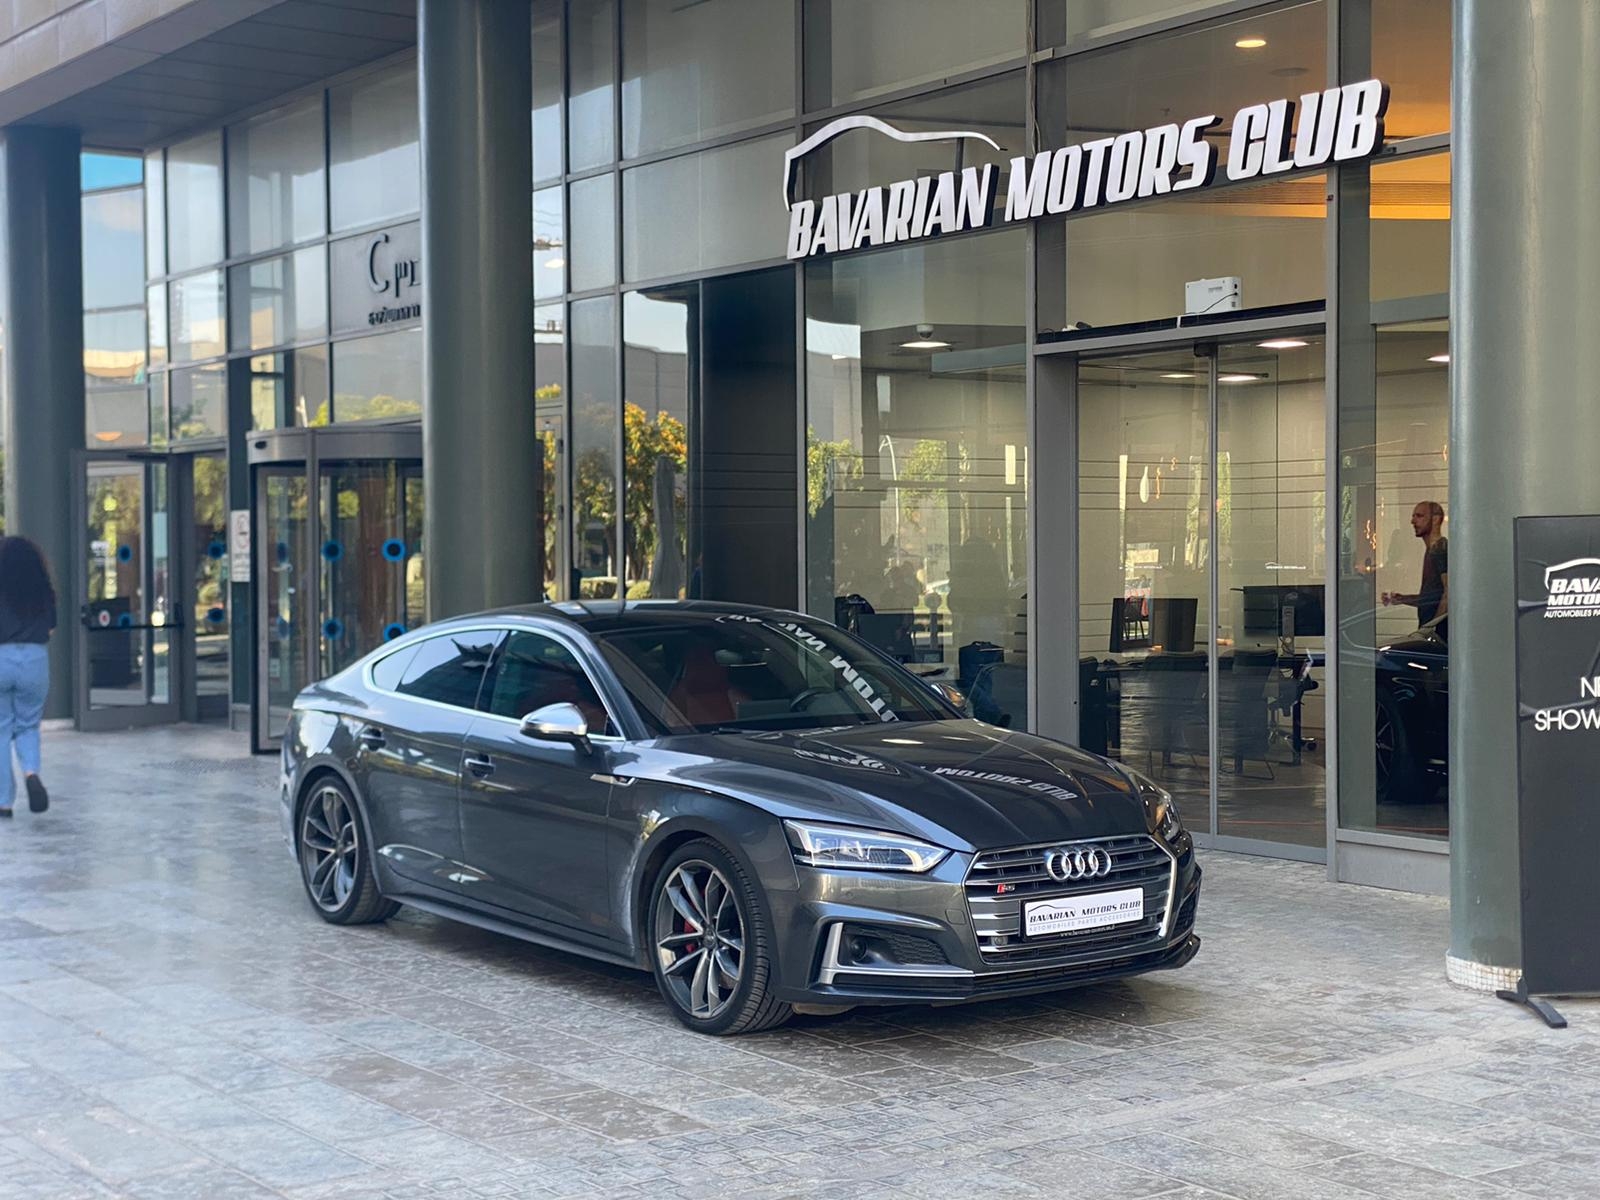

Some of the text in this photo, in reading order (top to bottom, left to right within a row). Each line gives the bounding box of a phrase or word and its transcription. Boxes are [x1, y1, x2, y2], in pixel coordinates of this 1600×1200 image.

[786, 79, 1388, 260] BAVARIAN MOTORS CLUB
[1544, 609, 1592, 618] AUTOMOBILES
[1534, 708, 1600, 731] SHOW
[1029, 900, 1142, 924] BAVARIAN MOTORS CLUB
